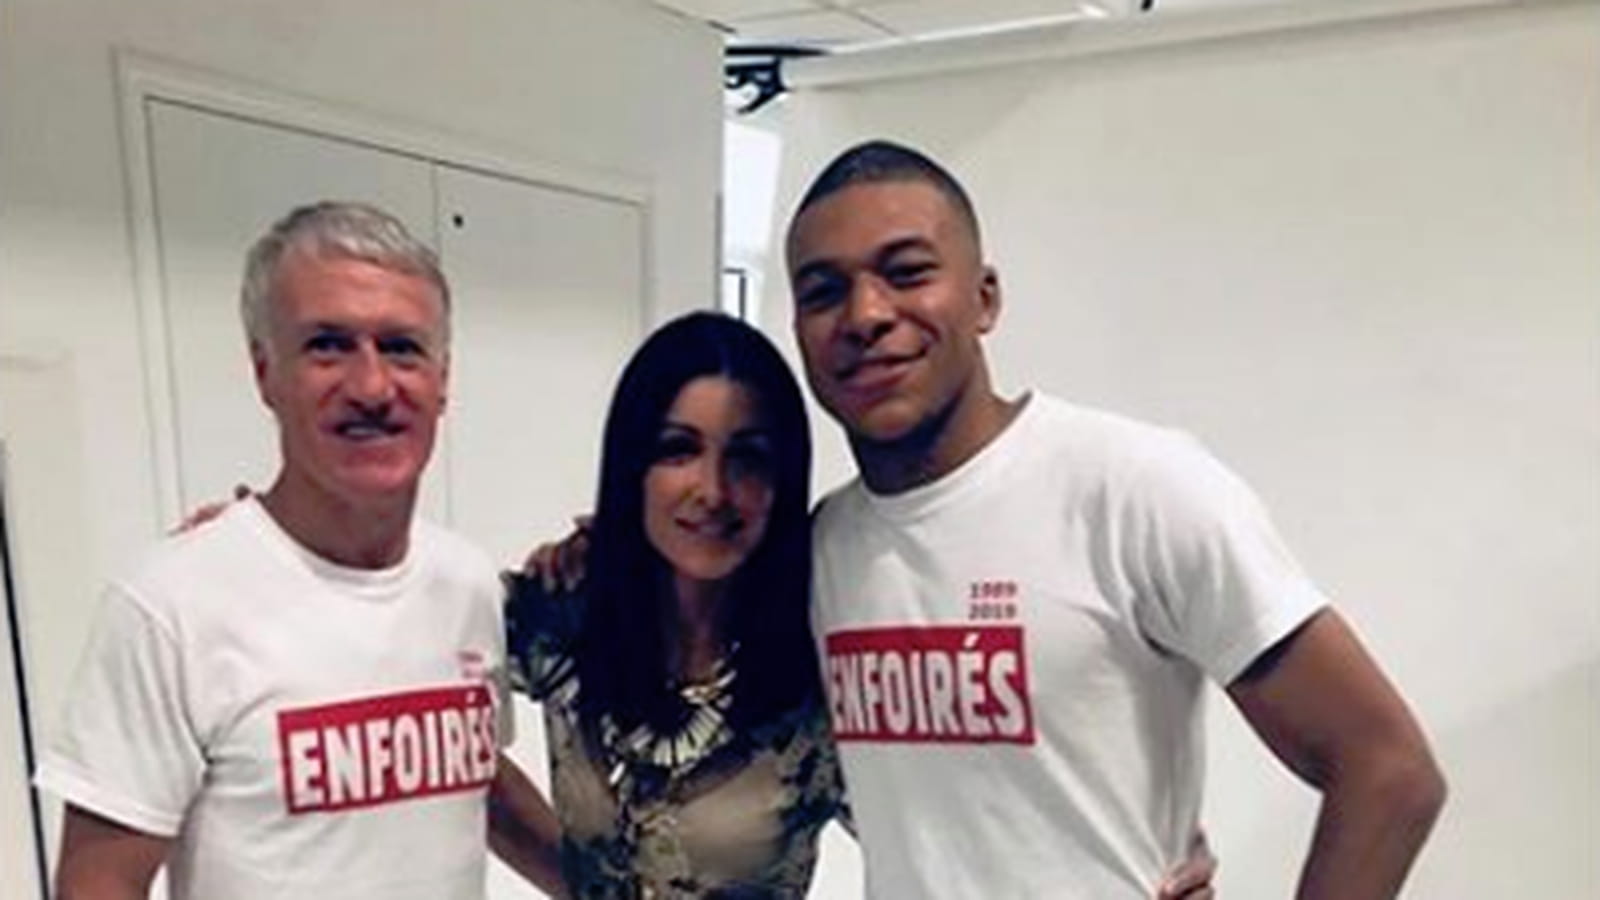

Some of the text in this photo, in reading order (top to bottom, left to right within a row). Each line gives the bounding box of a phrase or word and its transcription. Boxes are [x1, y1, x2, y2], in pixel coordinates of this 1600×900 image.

[968, 581, 1018, 600] 1989
[968, 602, 1017, 621] 2019
[829, 632, 1027, 737] ENFOIRÉS
